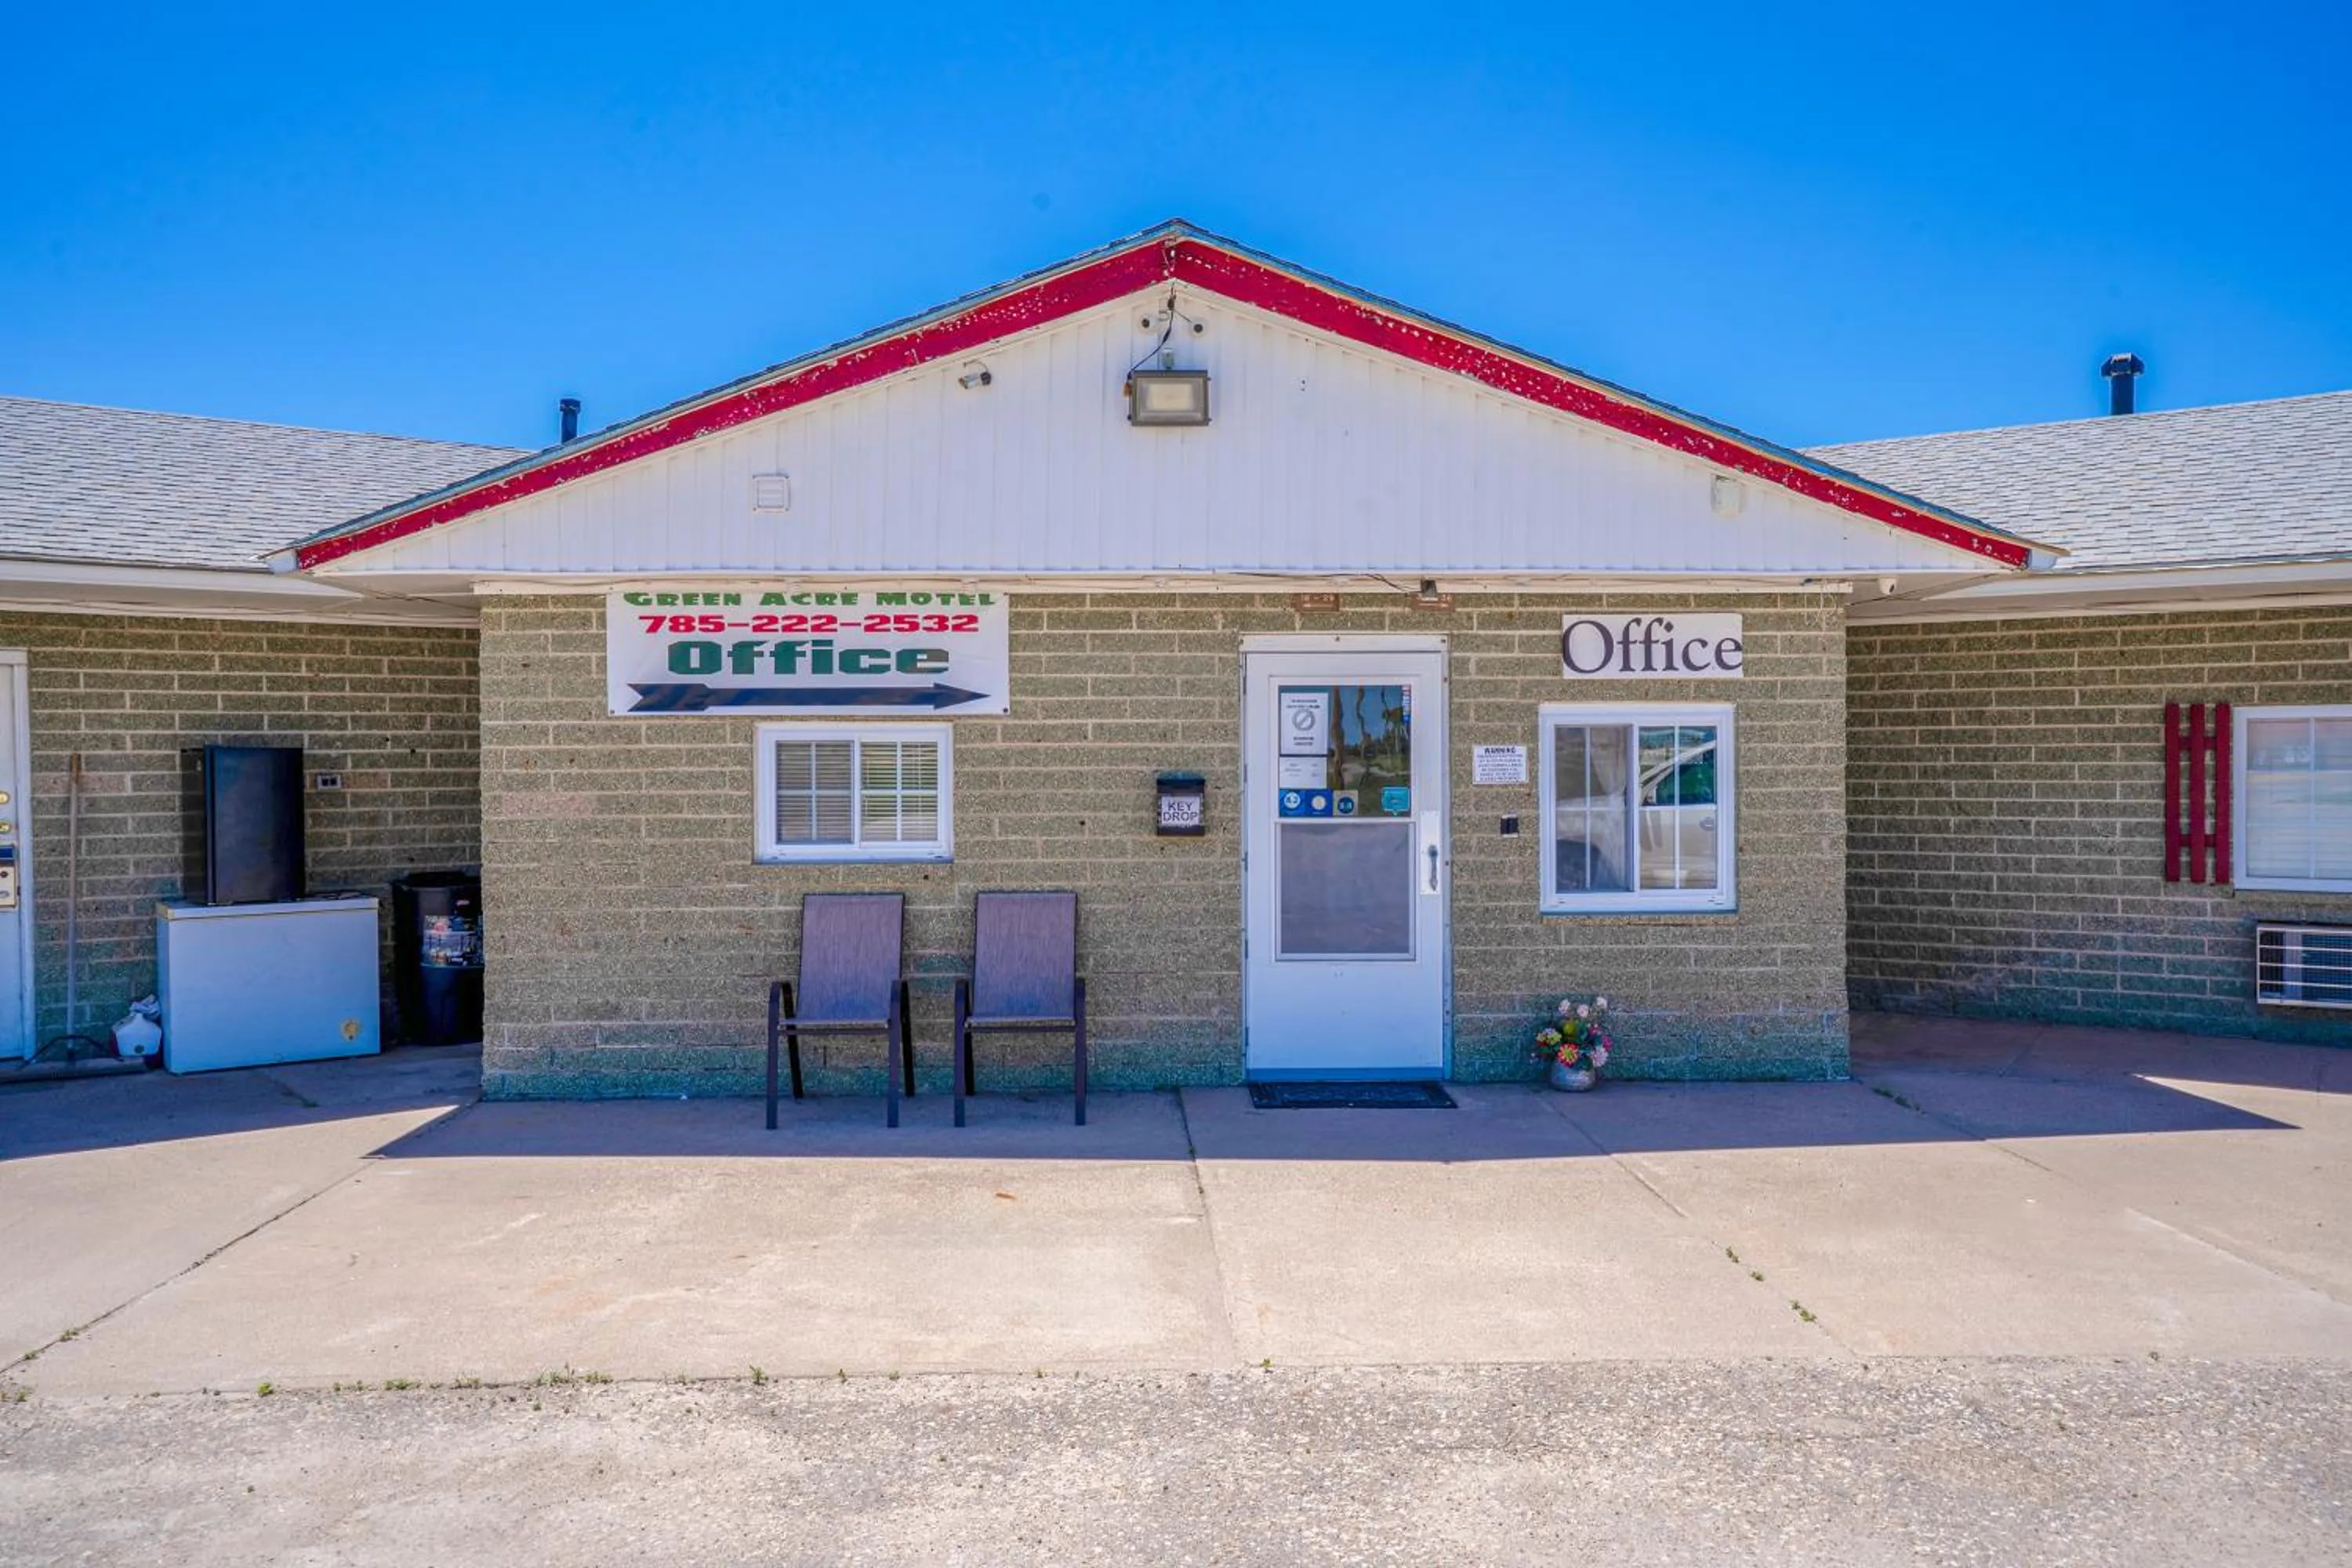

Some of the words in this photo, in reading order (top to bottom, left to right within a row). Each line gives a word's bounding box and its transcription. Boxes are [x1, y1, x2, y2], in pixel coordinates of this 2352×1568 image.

[623, 592, 741, 606] GREEN
[760, 592, 858, 606] ACRE
[877, 592, 996, 606] MOTEL
[639, 615, 979, 633] 785-222-2532
[1563, 617, 1743, 674] Office
[667, 639, 949, 675] Office
[1167, 802, 1192, 811] KEY
[1163, 811, 1198, 822] DROP
